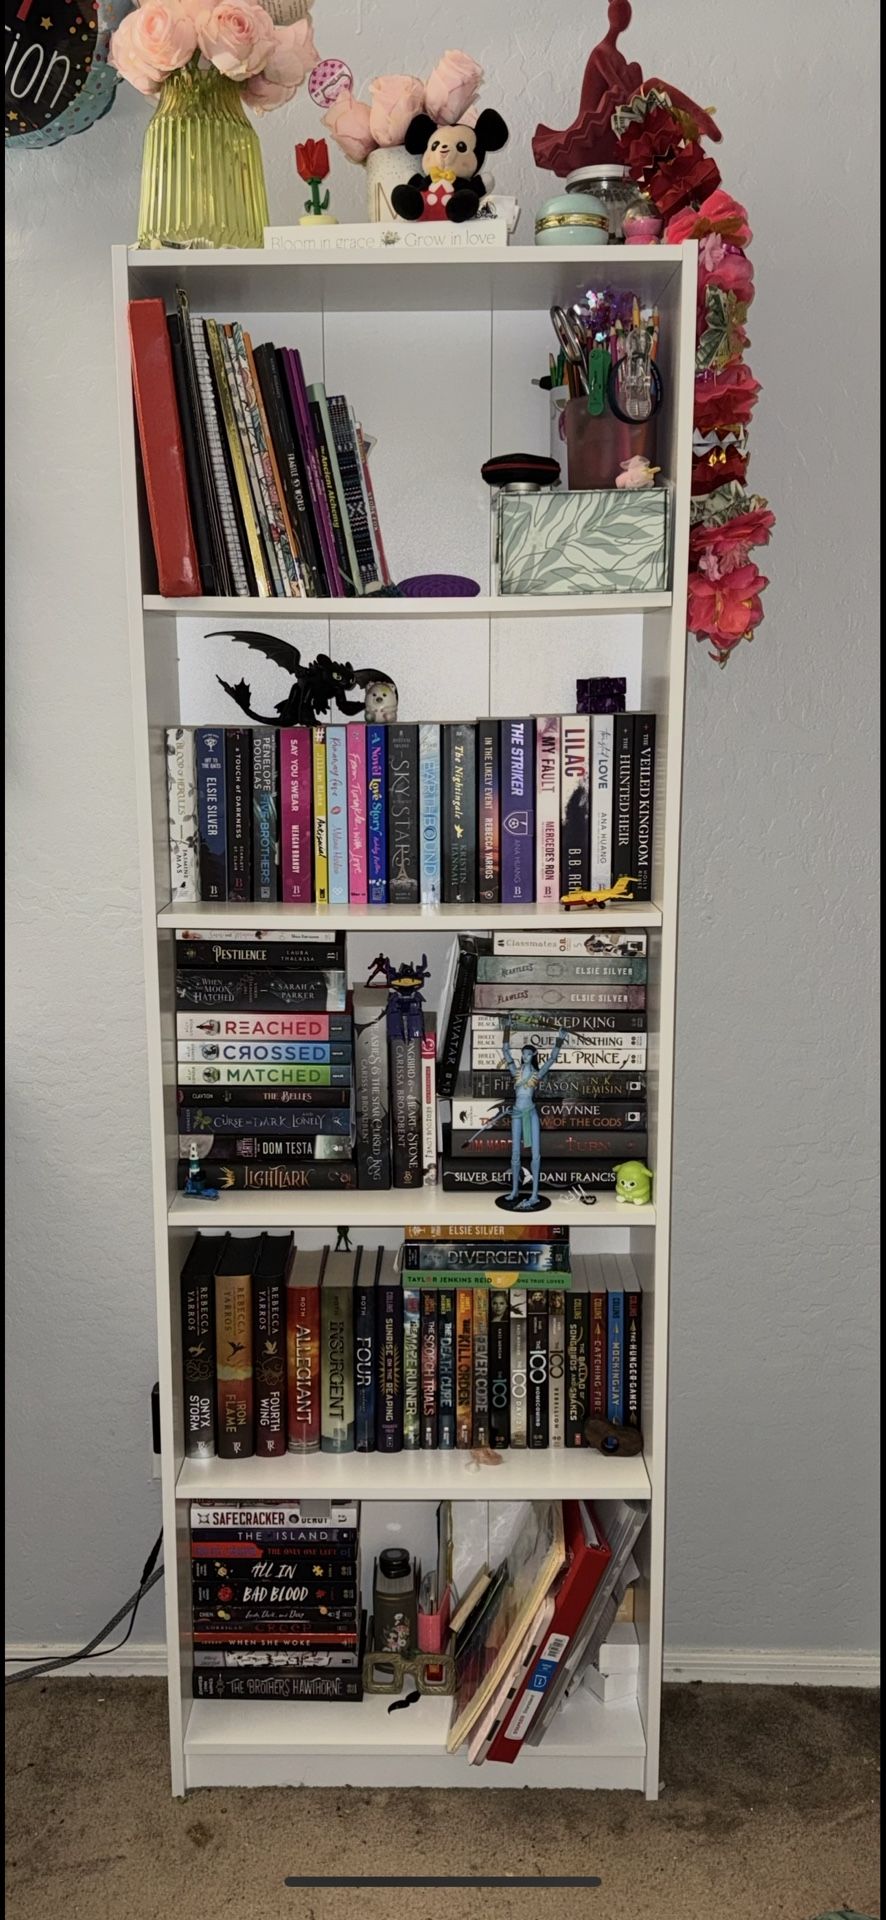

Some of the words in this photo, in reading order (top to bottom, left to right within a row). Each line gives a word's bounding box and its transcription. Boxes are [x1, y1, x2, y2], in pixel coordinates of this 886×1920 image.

[271, 237, 315, 249] Bloom
[320, 237, 330, 248] in
[336, 236, 375, 249] grace
[404, 233, 445, 247] Grow
[451, 232, 462, 246] in
[466, 231, 496, 245] love
[288, 454, 298, 477] FRAGILE
[295, 489, 305, 511] WORLD
[322, 457, 332, 488] Ancient
[328, 490, 340, 528] Alchemy
[511, 724, 524, 745] THE
[541, 736, 555, 754] MY
[371, 746, 381, 775] Novel
[455, 746, 463, 762] The
[565, 729, 585, 777] LILAC
[484, 764, 492, 785] LIKELY
[511, 748, 524, 796] STRIKER
[541, 759, 555, 792] FAULT
[599, 760, 608, 789] LOVE
[619, 754, 630, 811] HUNTED
[639, 748, 651, 798] VEILED
[207, 778, 217, 802] ELSIE
[370, 778, 381, 800] Love
[453, 765, 464, 819] Nightingale
[208, 805, 218, 836] SILVER
[370, 802, 382, 836] Story
[485, 818, 493, 850] REBECCA
[619, 813, 630, 846] HEIR
[638, 800, 650, 866] KINGDOM
[260, 822, 270, 883] BROTHERS
[545, 822, 554, 860] MERCEDES
[485, 852, 493, 879] YARROS
[212, 946, 267, 962] PESTILENCE
[576, 967, 598, 975] ELSIE
[603, 967, 632, 975] SILVER
[193, 992, 234, 1001] HATCHED
[571, 994, 595, 1002] ELSIE
[598, 994, 628, 1002] SILVER
[583, 1017, 615, 1030] KING
[446, 1016, 463, 1065] AVATAR
[227, 1069, 321, 1082] MATCHED
[396, 1046, 405, 1086] CARISSA
[572, 1053, 620, 1067] PRINCE
[281, 1091, 312, 1102] BELLES
[407, 1094, 418, 1126] HEART
[541, 1105, 600, 1115] GWYNNE
[213, 1114, 244, 1128] CURSE
[254, 1119, 287, 1128] DARK
[292, 1114, 326, 1129] LONELY
[397, 1090, 406, 1148] BROADBENT
[571, 1117, 590, 1126] THE
[593, 1117, 622, 1127] GODS
[262, 1142, 283, 1155] DOM
[286, 1142, 313, 1155] TESTA
[371, 1119, 382, 1155] CURSED
[407, 1132, 419, 1168] STONE
[243, 1165, 315, 1188] LIGHTLARK
[455, 1172, 487, 1182] SILVER
[540, 1172, 567, 1182] DANI
[571, 1172, 616, 1182] FRANCIS
[450, 1226, 473, 1235] ELSIE
[476, 1226, 504, 1235] SILVER
[448, 1251, 541, 1264] DIVERGENT
[200, 1287, 208, 1335] REBECCA
[224, 1292, 232, 1332] YARROS
[386, 1318, 394, 1356] SUNRISE
[329, 1321, 344, 1421] INSURGENT
[357, 1337, 371, 1386] FOUR
[424, 1335, 434, 1376] SCORCH
[440, 1338, 451, 1373] DEATH
[529, 1350, 546, 1384] 100
[550, 1350, 563, 1379] 100
[594, 1340, 602, 1386] CATCHING
[629, 1344, 637, 1380] HUNGER
[296, 1324, 312, 1424] ALLEGIANT
[512, 1369, 526, 1398] 100
[386, 1382, 394, 1422] REAPING
[406, 1369, 417, 1415] RUNNER
[424, 1379, 434, 1416] TRIALS
[440, 1376, 452, 1407] CURE
[629, 1383, 637, 1411] GAMES
[190, 1395, 199, 1431] STORM
[200, 1398, 210, 1427] ONYX
[226, 1394, 236, 1433] FLAME
[237, 1400, 246, 1425] IRON
[260, 1398, 269, 1426] WING
[270, 1392, 280, 1432] FOURTH
[213, 1512, 284, 1525] SAFECRACKER
[252, 1562, 273, 1578] ALL
[243, 1586, 267, 1602] BAD
[270, 1587, 308, 1602] BLOOD
[227, 1679, 244, 1693] THE
[247, 1678, 289, 1697] BROTHERS
[292, 1677, 342, 1695] HAWTHORNE
